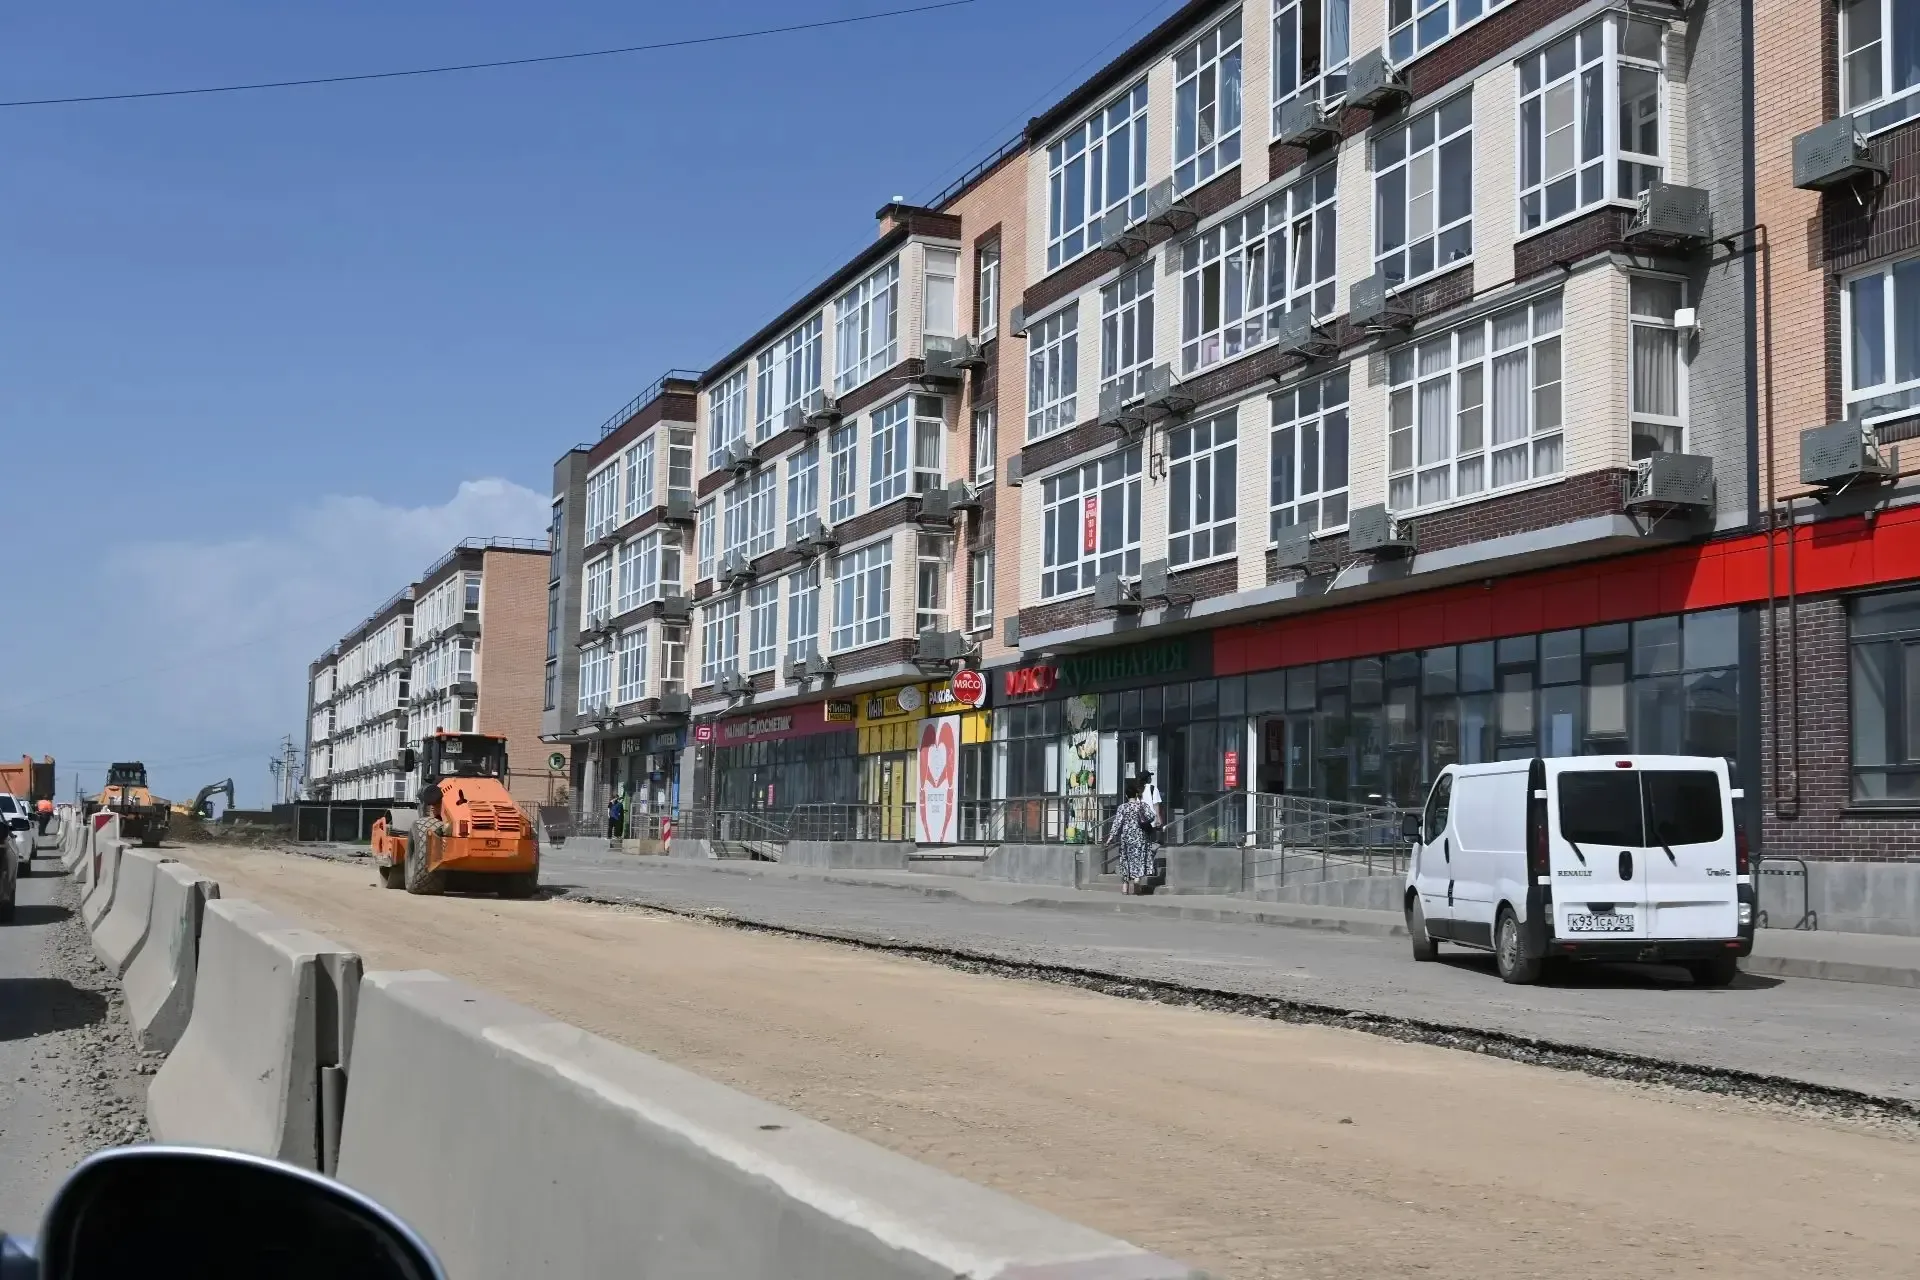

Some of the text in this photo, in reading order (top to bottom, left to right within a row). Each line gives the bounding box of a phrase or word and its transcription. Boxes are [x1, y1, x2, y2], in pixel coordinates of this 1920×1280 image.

[1061, 643, 1184, 689] КУЛИНАРИЯ
[954, 679, 981, 690] МЯСО
[1005, 666, 1056, 696] МЯСО
[929, 689, 956, 705] РАКОВА
[554, 757, 561, 766] F
[1615, 915, 1631, 924] 761
